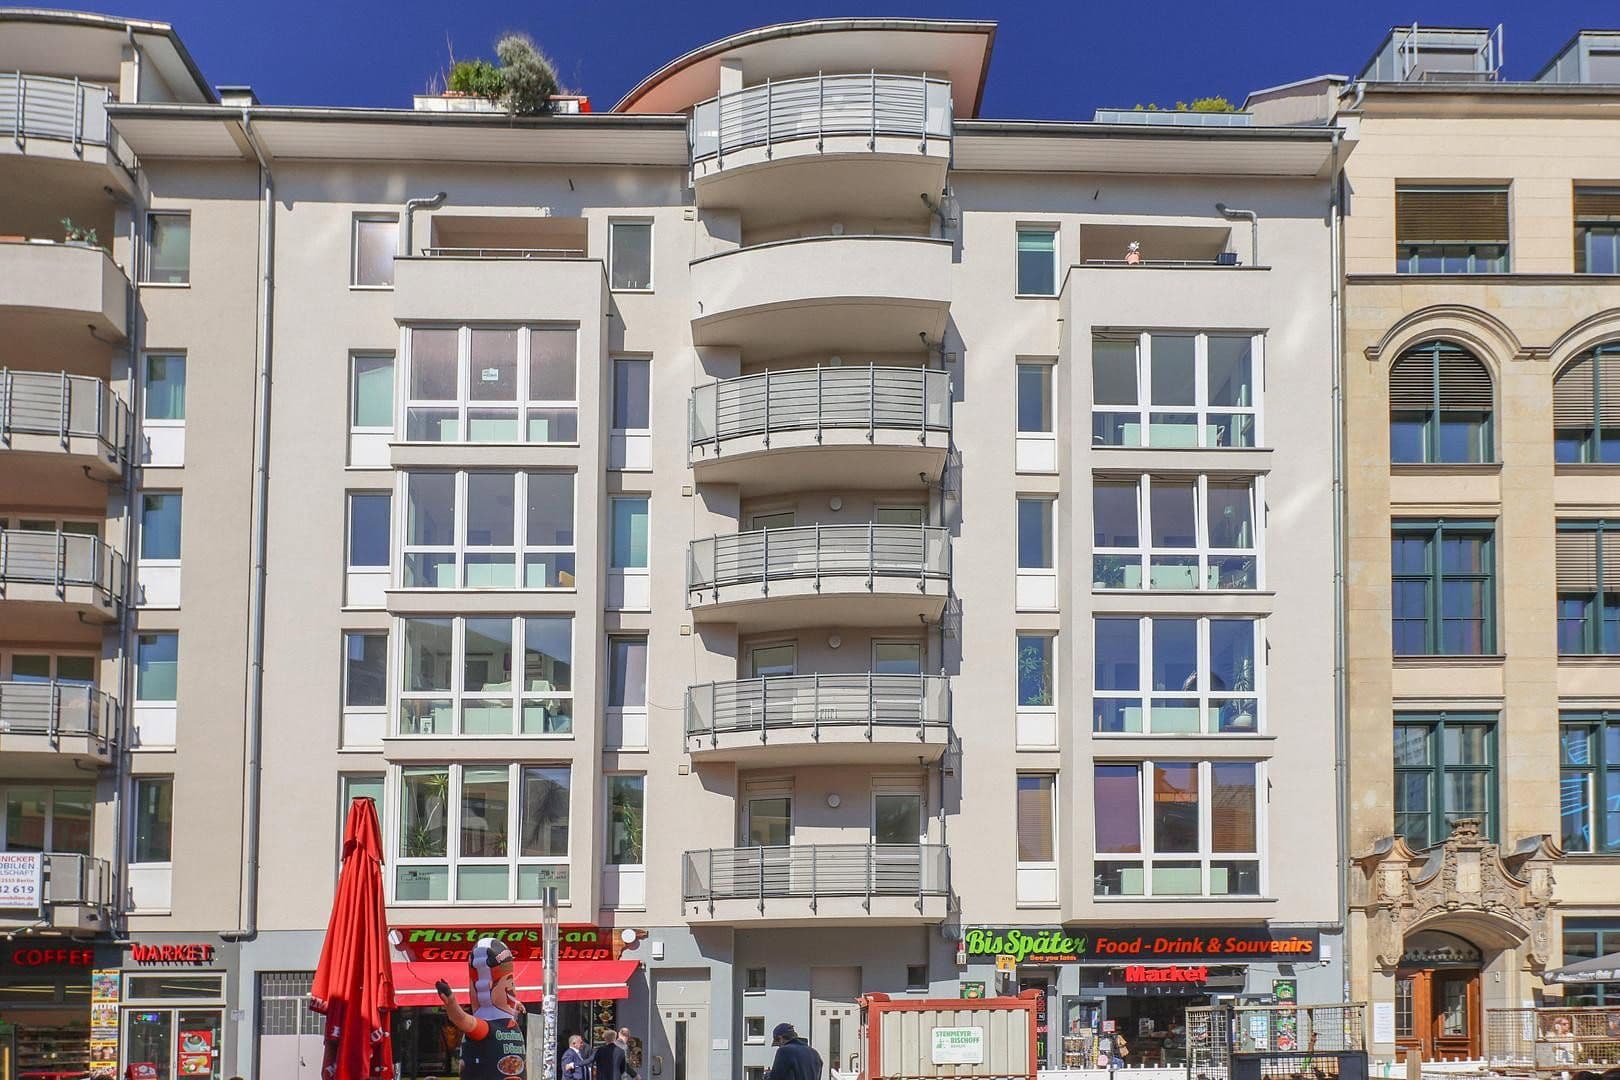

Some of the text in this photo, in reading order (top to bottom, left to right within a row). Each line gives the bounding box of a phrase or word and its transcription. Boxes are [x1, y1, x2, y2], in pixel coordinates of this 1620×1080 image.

[13, 885, 34, 894] 619
[409, 929, 597, 942] Mustafa's an
[131, 943, 213, 961] MARKET
[1095, 937, 1141, 953] Food
[1153, 937, 1203, 953] Drink
[1206, 937, 1221, 953] &
[1224, 936, 1313, 953] Souvenirs
[12, 947, 95, 966] COFFEE
[1125, 965, 1208, 982] Market
